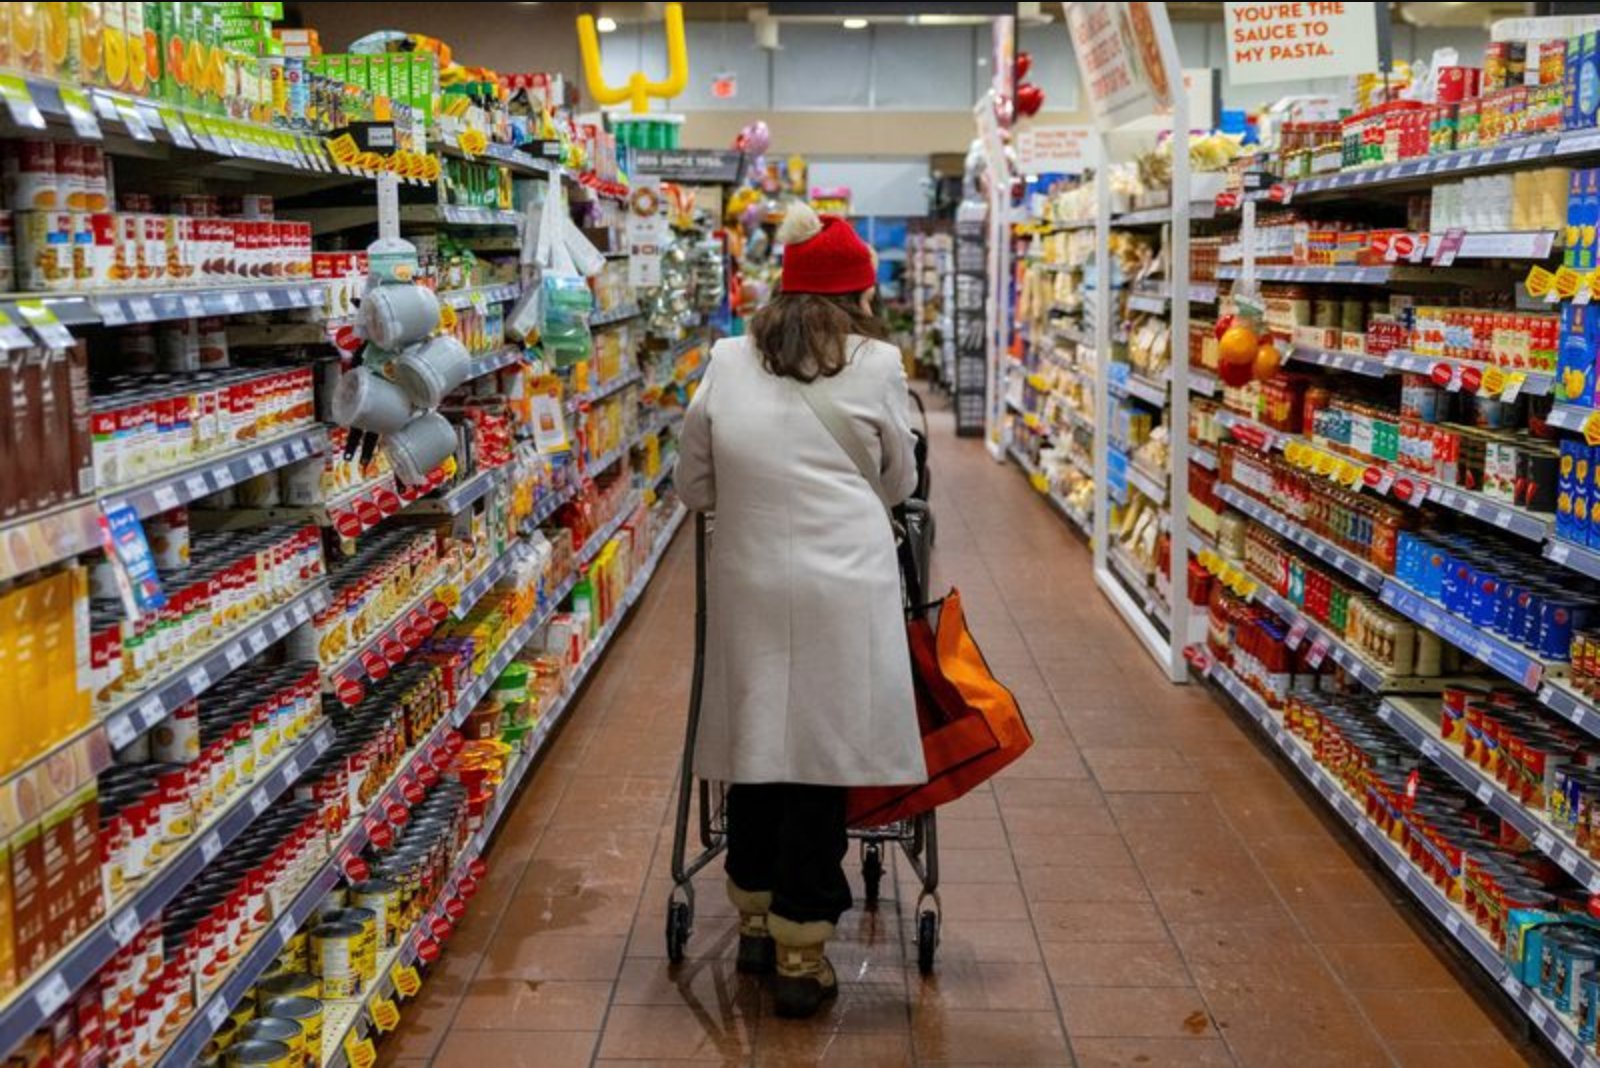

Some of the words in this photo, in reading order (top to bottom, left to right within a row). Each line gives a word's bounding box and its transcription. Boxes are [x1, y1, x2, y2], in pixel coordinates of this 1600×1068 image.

[1233, 4, 1303, 22] YOU'RE
[1308, 2, 1344, 15] THE
[1234, 24, 1296, 43] SAUCE
[1303, 21, 1328, 36] TO
[1235, 47, 1264, 63] MY
[1270, 41, 1334, 60] PASTA.
